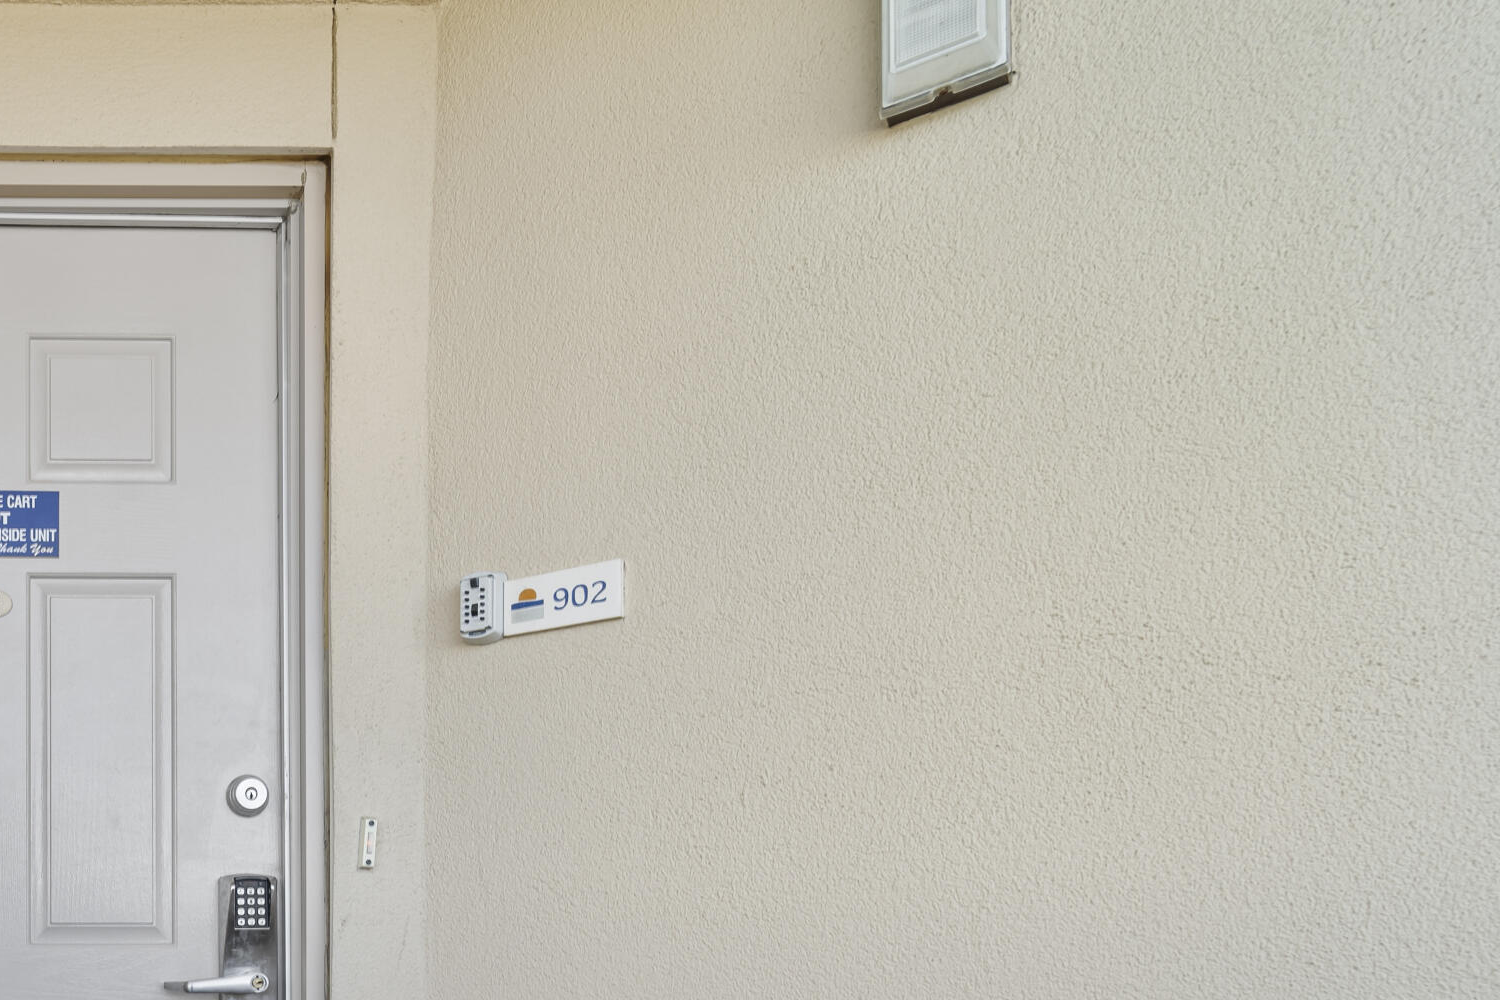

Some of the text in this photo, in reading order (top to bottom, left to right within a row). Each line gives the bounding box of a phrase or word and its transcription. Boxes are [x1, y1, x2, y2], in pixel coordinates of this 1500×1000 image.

[7, 494, 38, 509] CART
[30, 528, 57, 542] UNIT
[30, 543, 54, 556] You
[553, 580, 607, 611] 902
